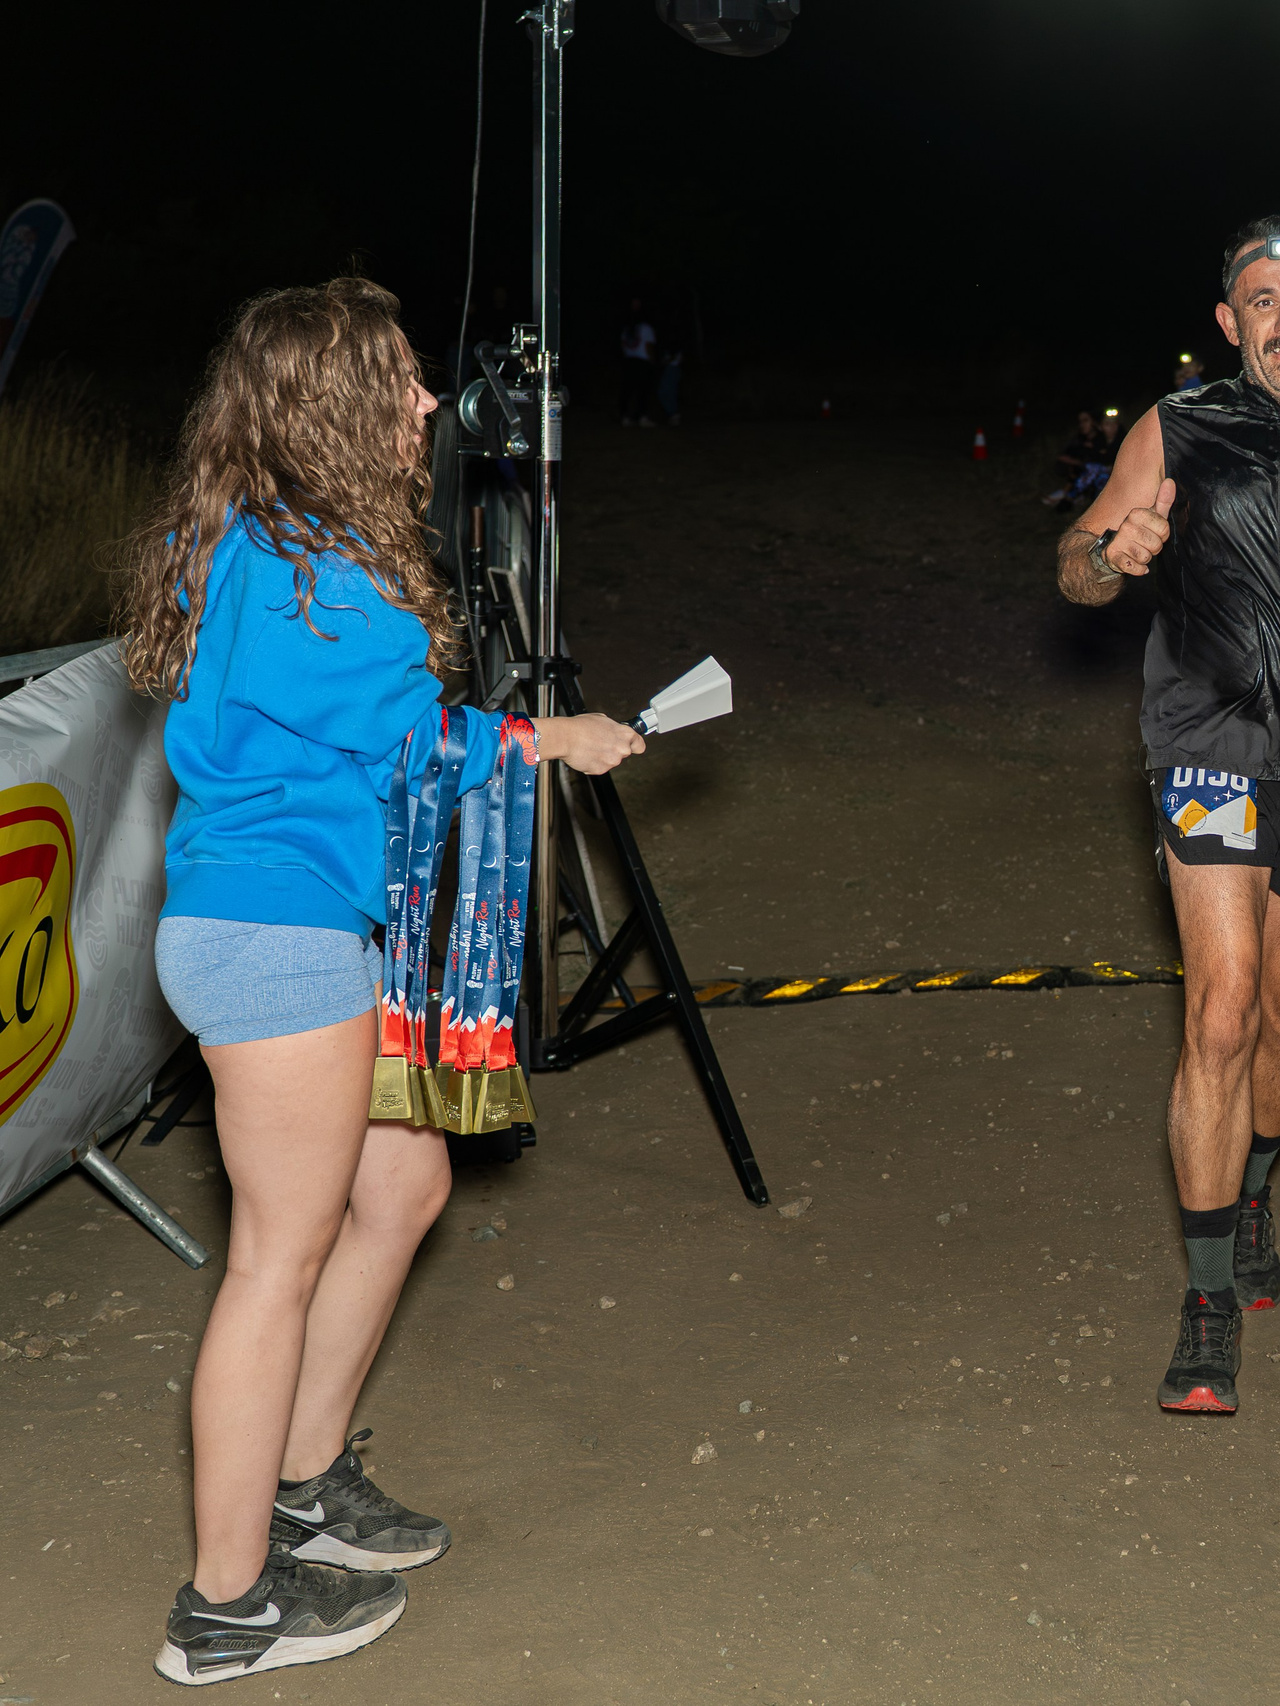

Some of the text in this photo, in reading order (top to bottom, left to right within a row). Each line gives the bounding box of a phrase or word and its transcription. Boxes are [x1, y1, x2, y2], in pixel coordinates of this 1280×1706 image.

[408, 884, 421, 907] Run
[410, 905, 423, 935] Night
[475, 900, 493, 950] Night Run
[507, 899, 525, 947] Night Run
